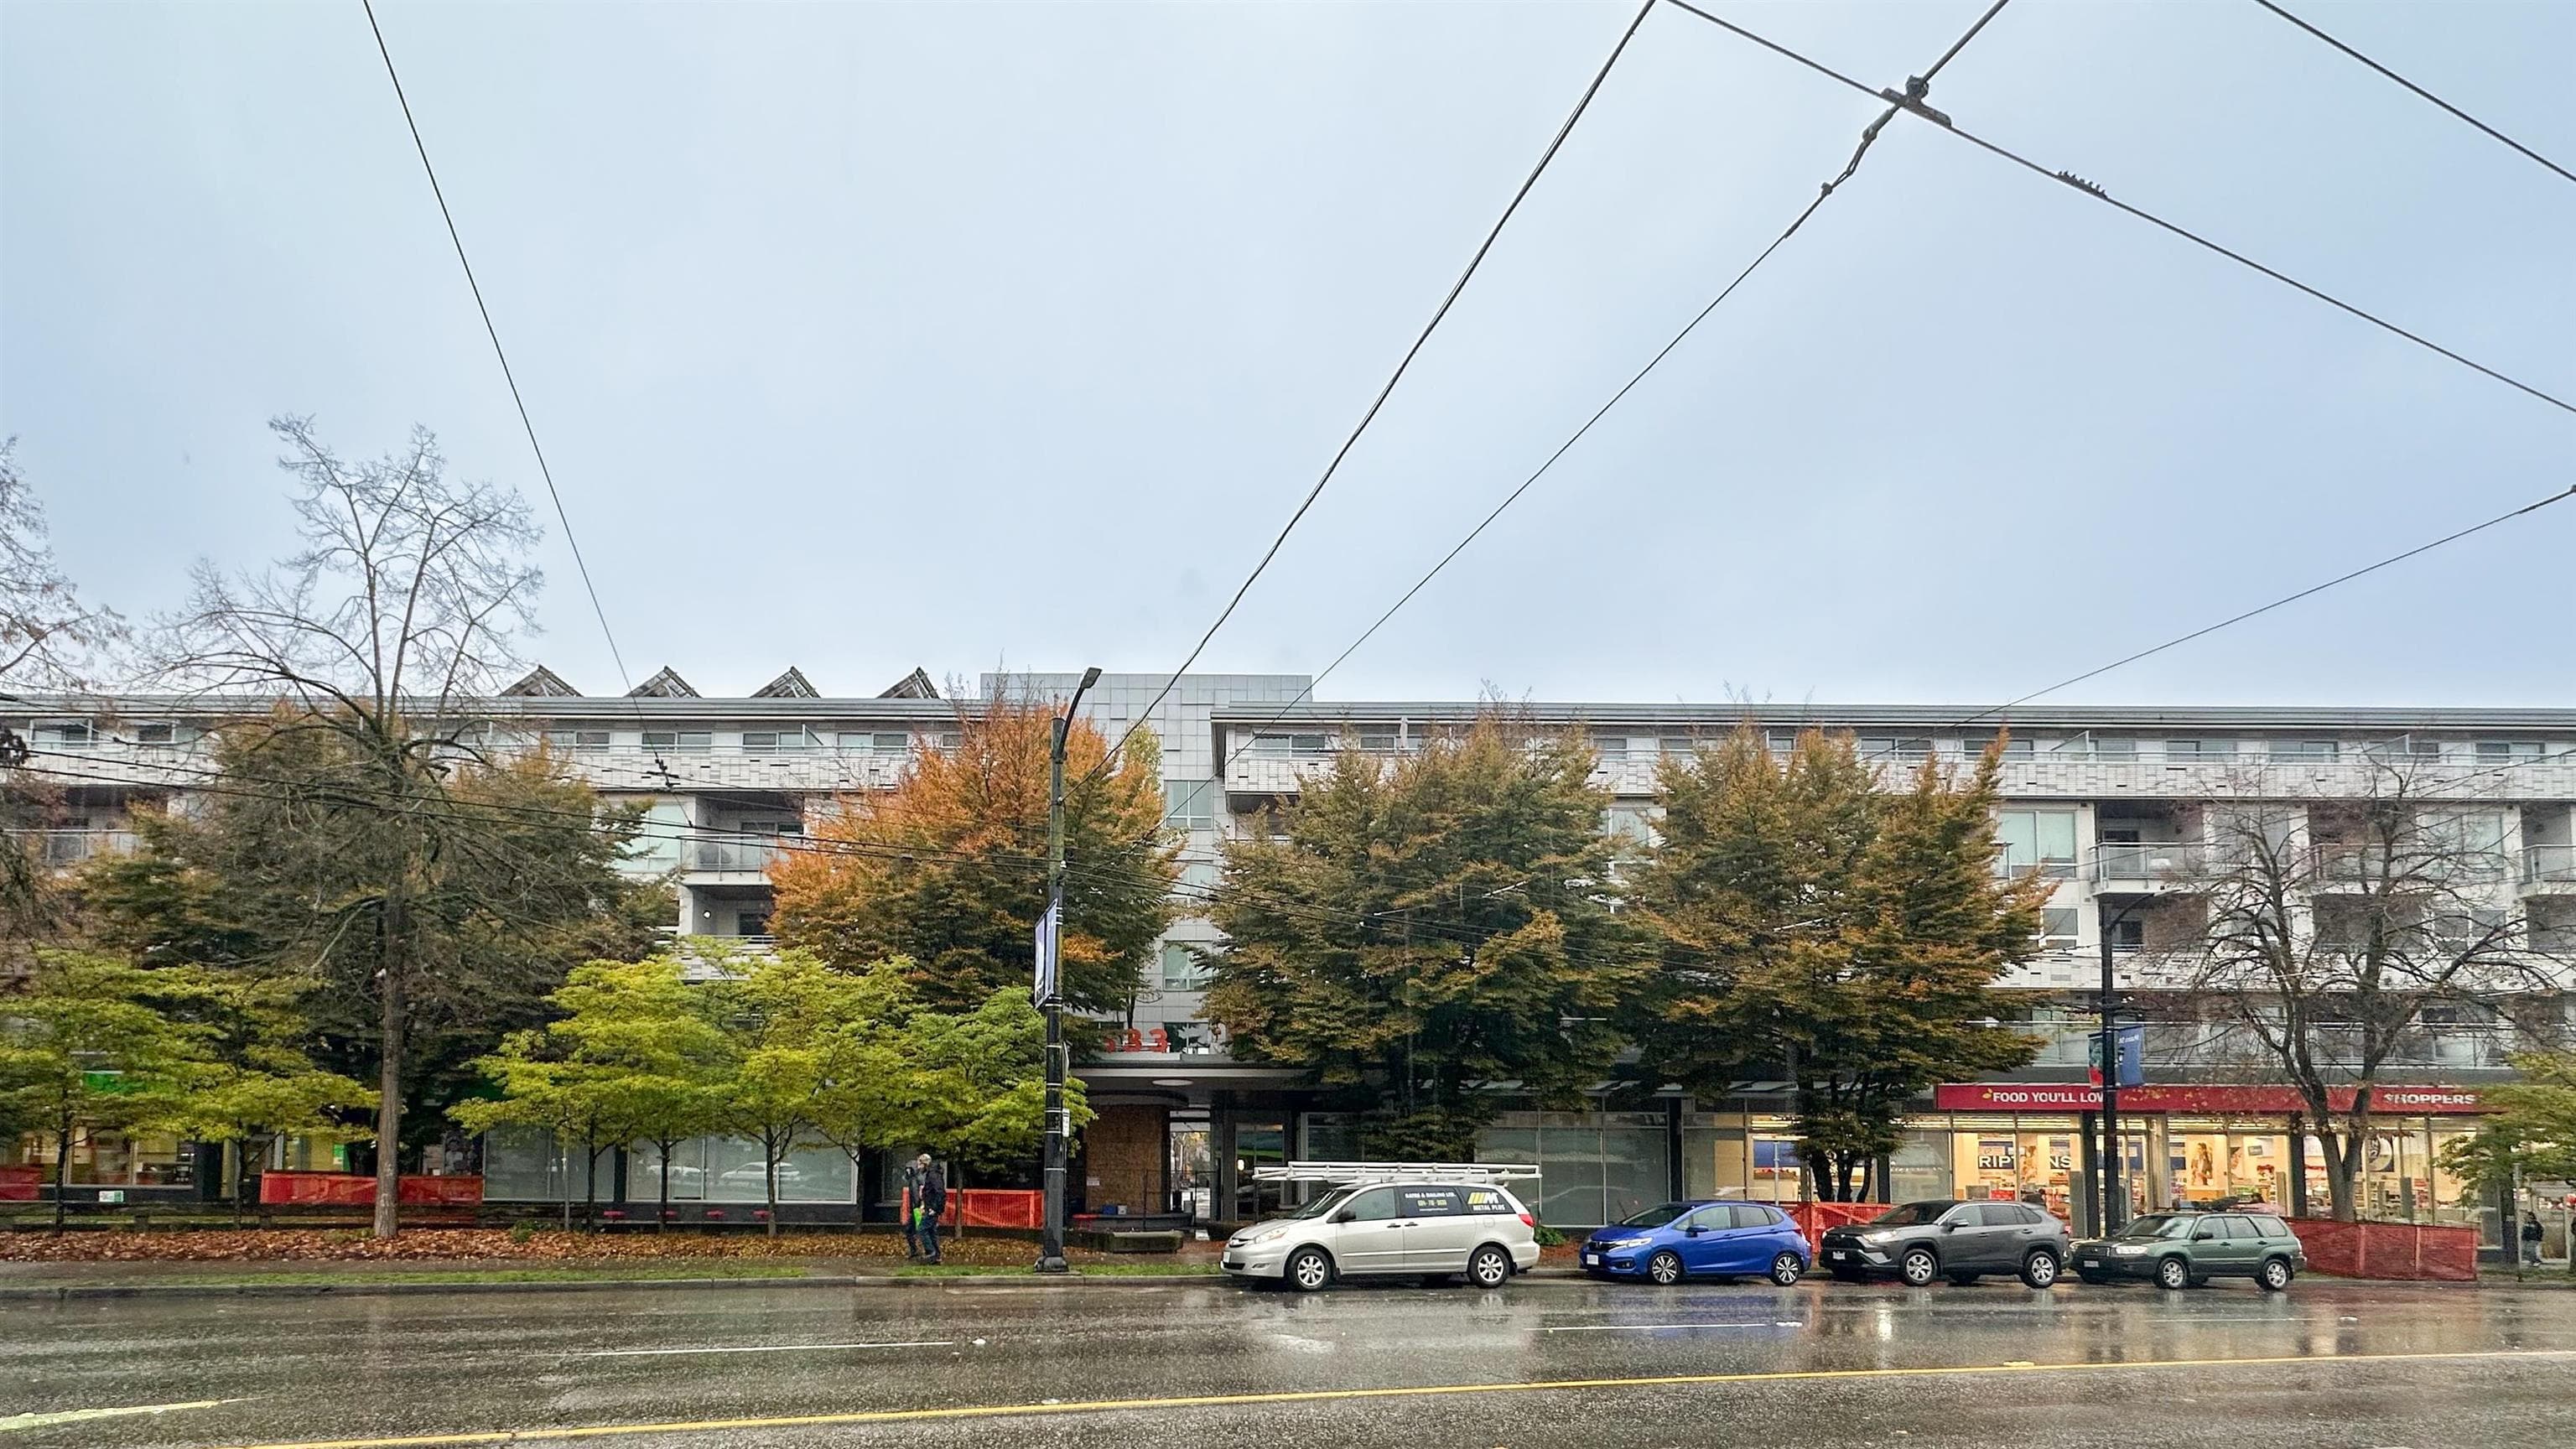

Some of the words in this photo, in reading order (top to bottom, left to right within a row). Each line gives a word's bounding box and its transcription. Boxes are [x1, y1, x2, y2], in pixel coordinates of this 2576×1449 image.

[1992, 1093, 2028, 1103] FOOD
[2032, 1092, 2077, 1103] YOU'LL
[2080, 1092, 2104, 1103] LOV
[2384, 1093, 2475, 1104] SHOPPERS
